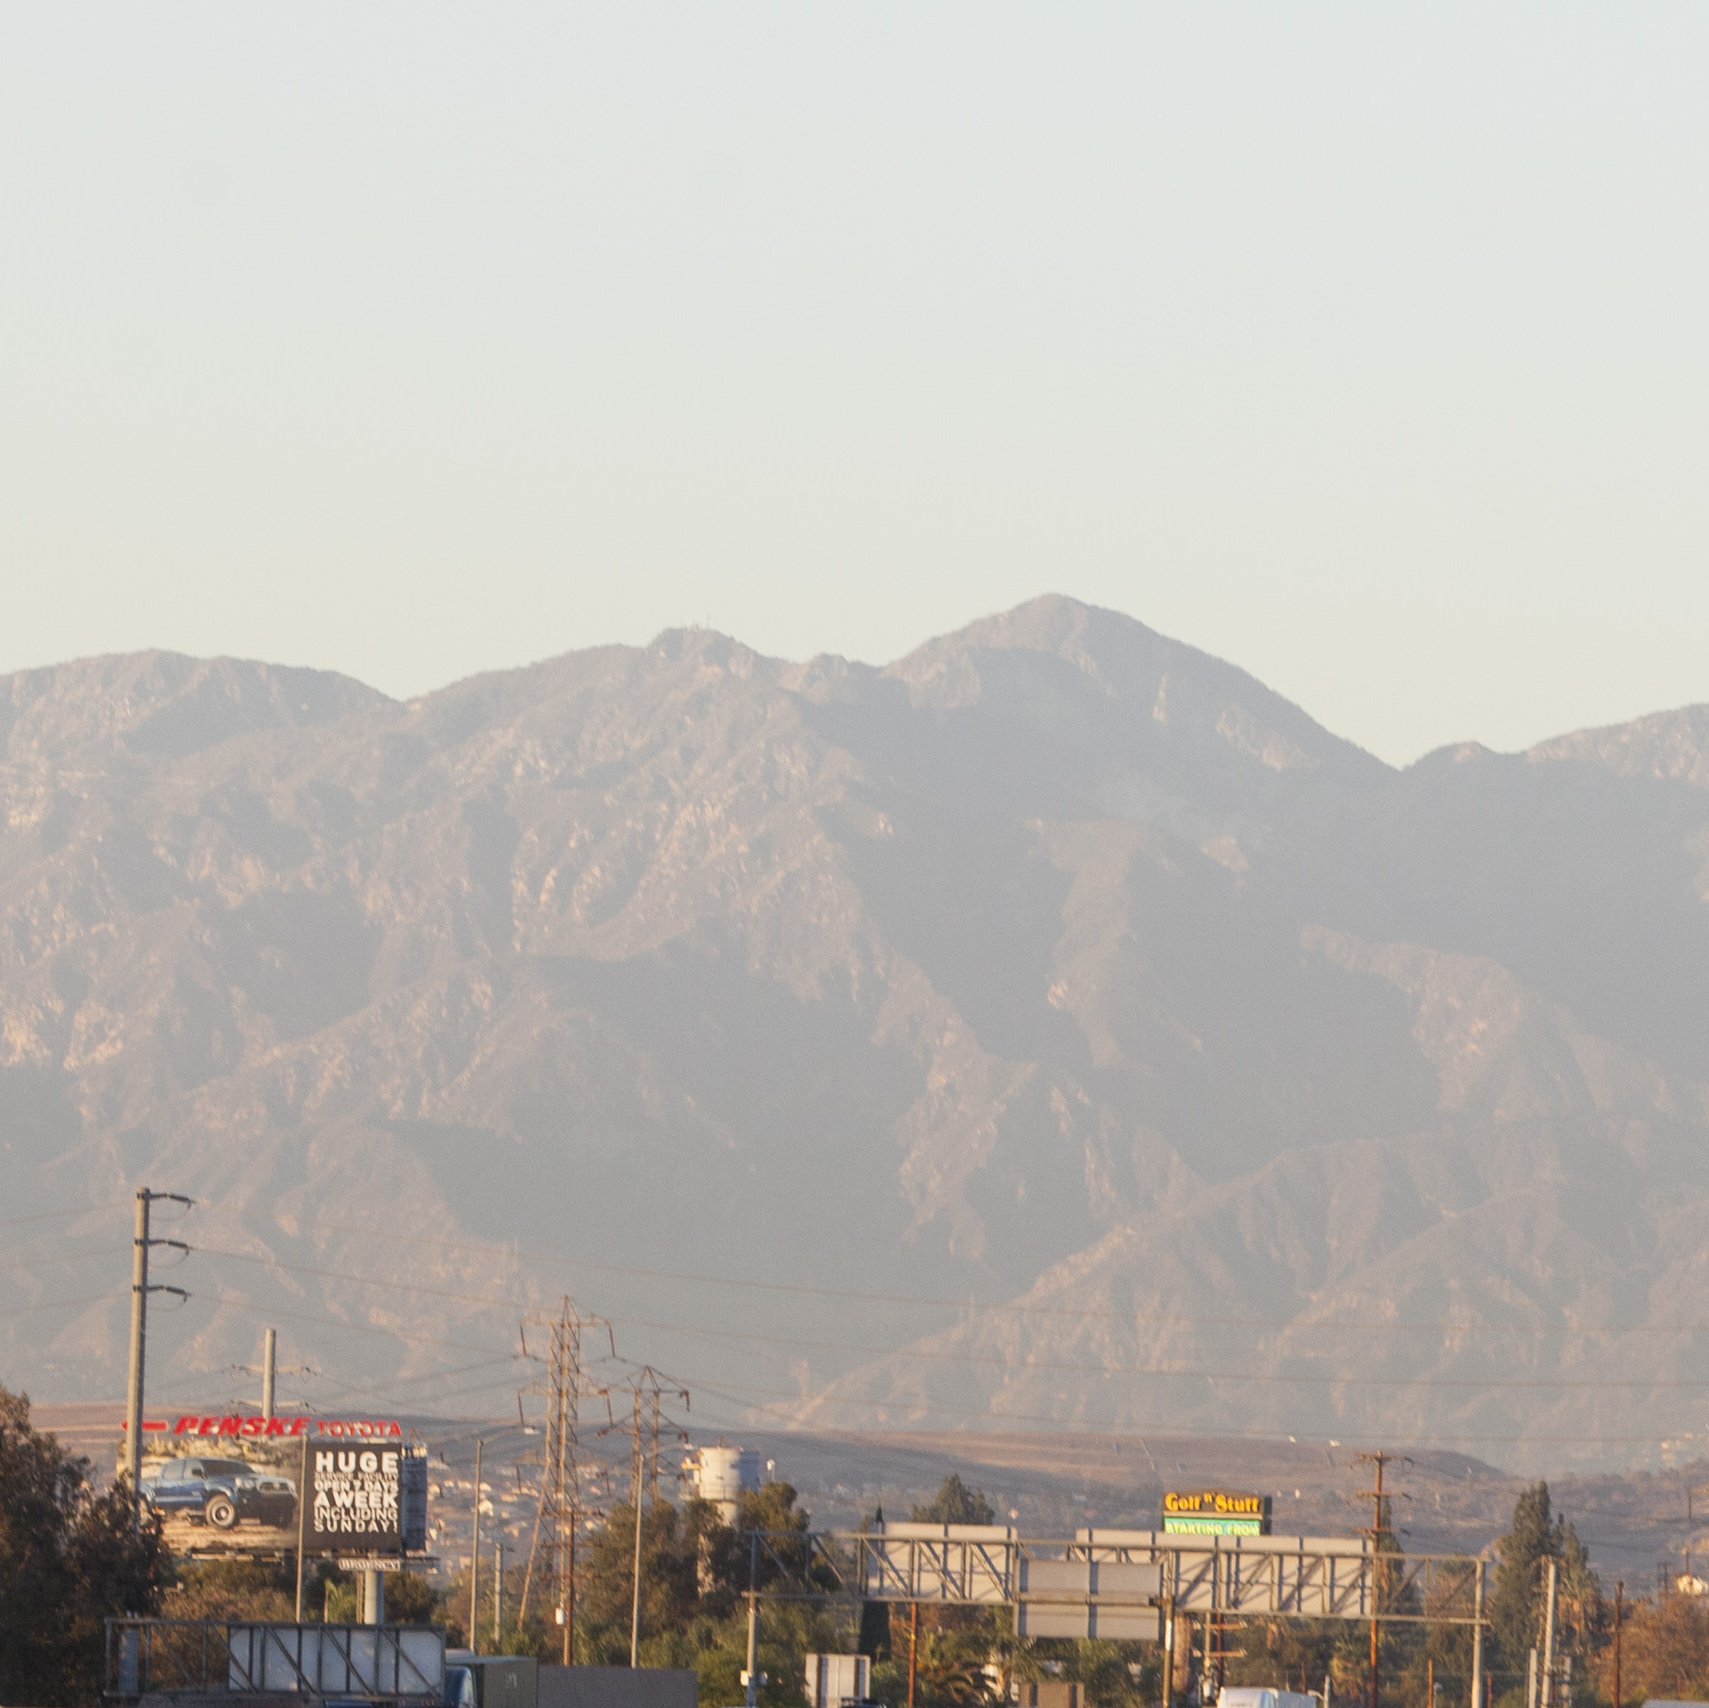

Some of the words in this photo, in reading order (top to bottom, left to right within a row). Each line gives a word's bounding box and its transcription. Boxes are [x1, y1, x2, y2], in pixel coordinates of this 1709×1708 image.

[173, 1417, 313, 1436] PENSKE
[315, 1421, 403, 1437] TOYOTA
[315, 1451, 399, 1473] HUGE
[314, 1479, 350, 1491] OPEN
[353, 1479, 362, 1491] 7
[364, 1480, 399, 1492] DAYS
[314, 1491, 330, 1508] A
[332, 1491, 398, 1509] WEEK
[1165, 1492, 1201, 1511] Golf
[1215, 1494, 1259, 1513] Stuff
[314, 1507, 399, 1521] INCLUDING
[313, 1520, 398, 1533] SUNDAY!
